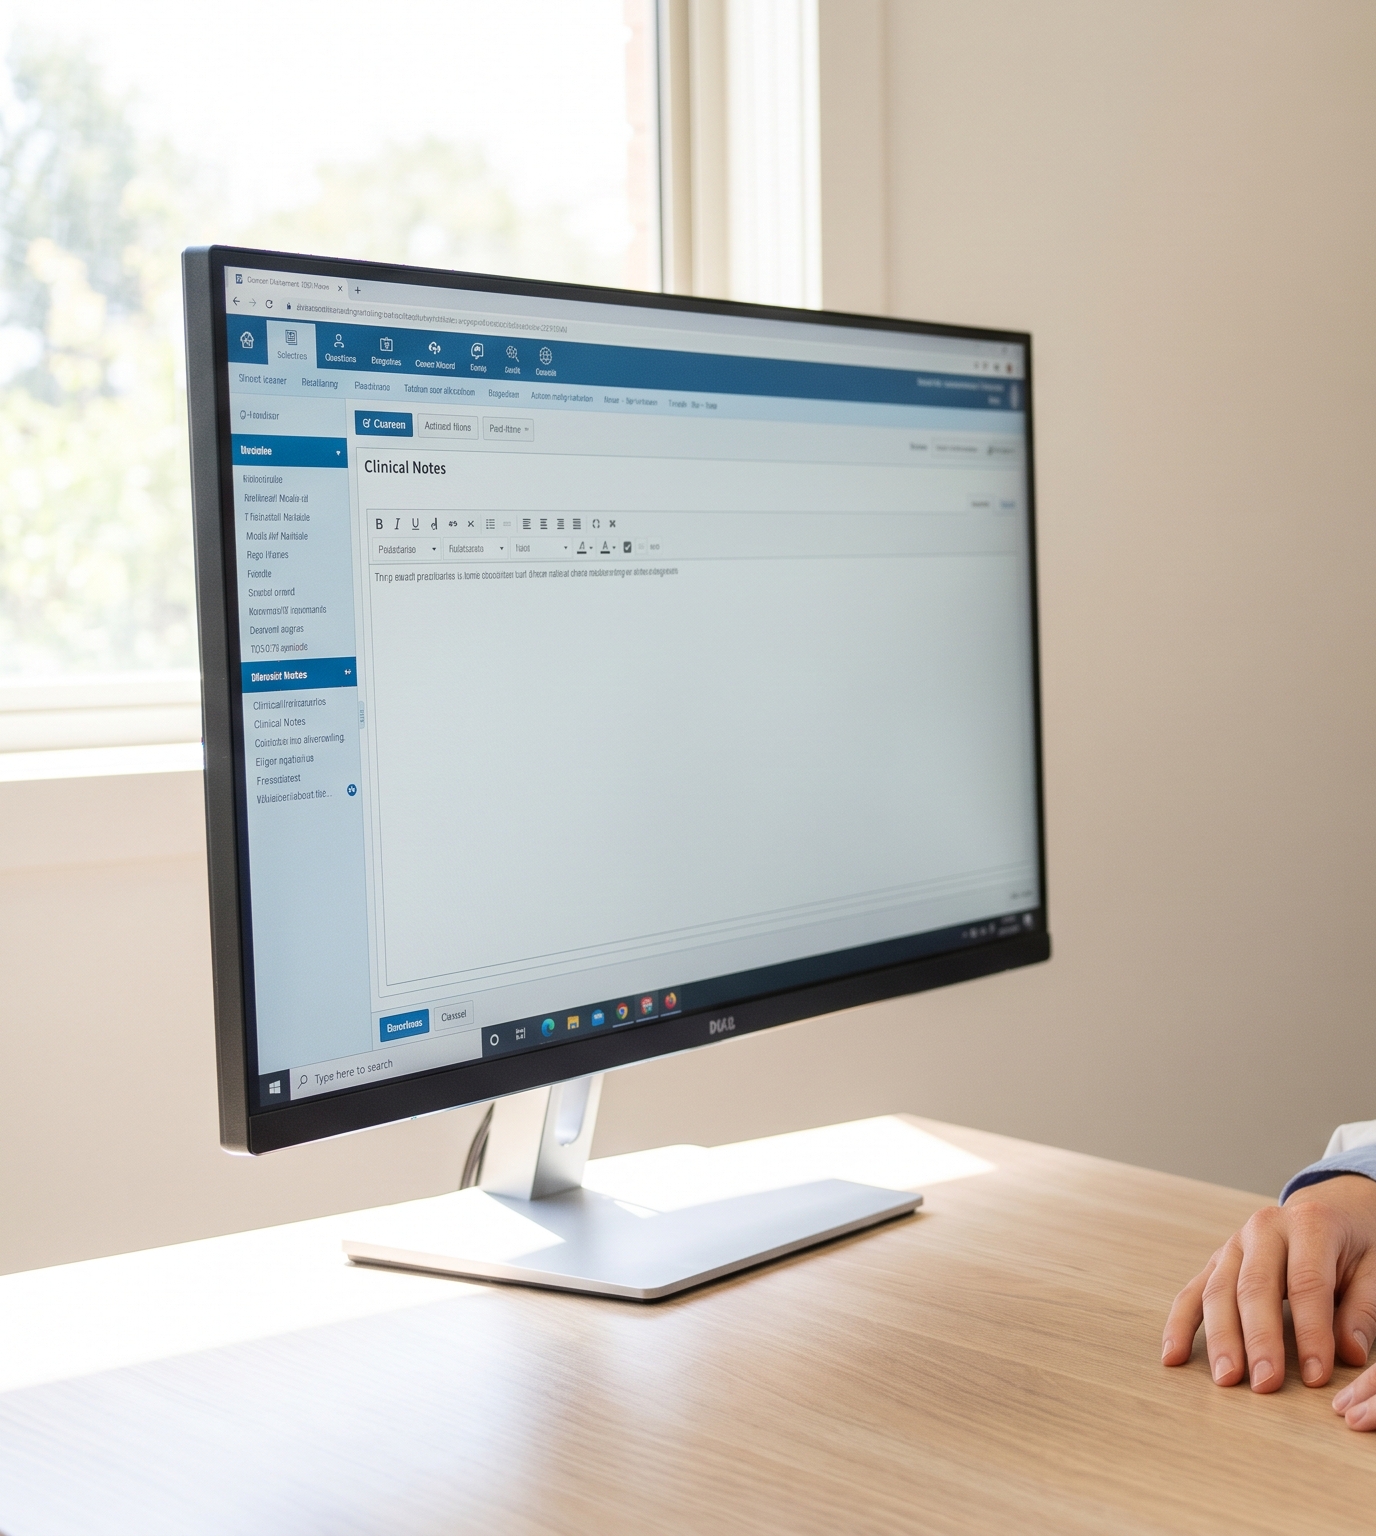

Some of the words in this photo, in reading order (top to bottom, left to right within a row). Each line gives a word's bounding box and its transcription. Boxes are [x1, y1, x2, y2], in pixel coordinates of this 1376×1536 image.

[364, 459, 409, 475] Clinical
[412, 461, 447, 475] Notes
[283, 717, 307, 727] Notes
[314, 1072, 334, 1085] Type
[336, 1067, 355, 1081] here
[356, 1065, 366, 1076] to
[367, 1058, 394, 1073] search
